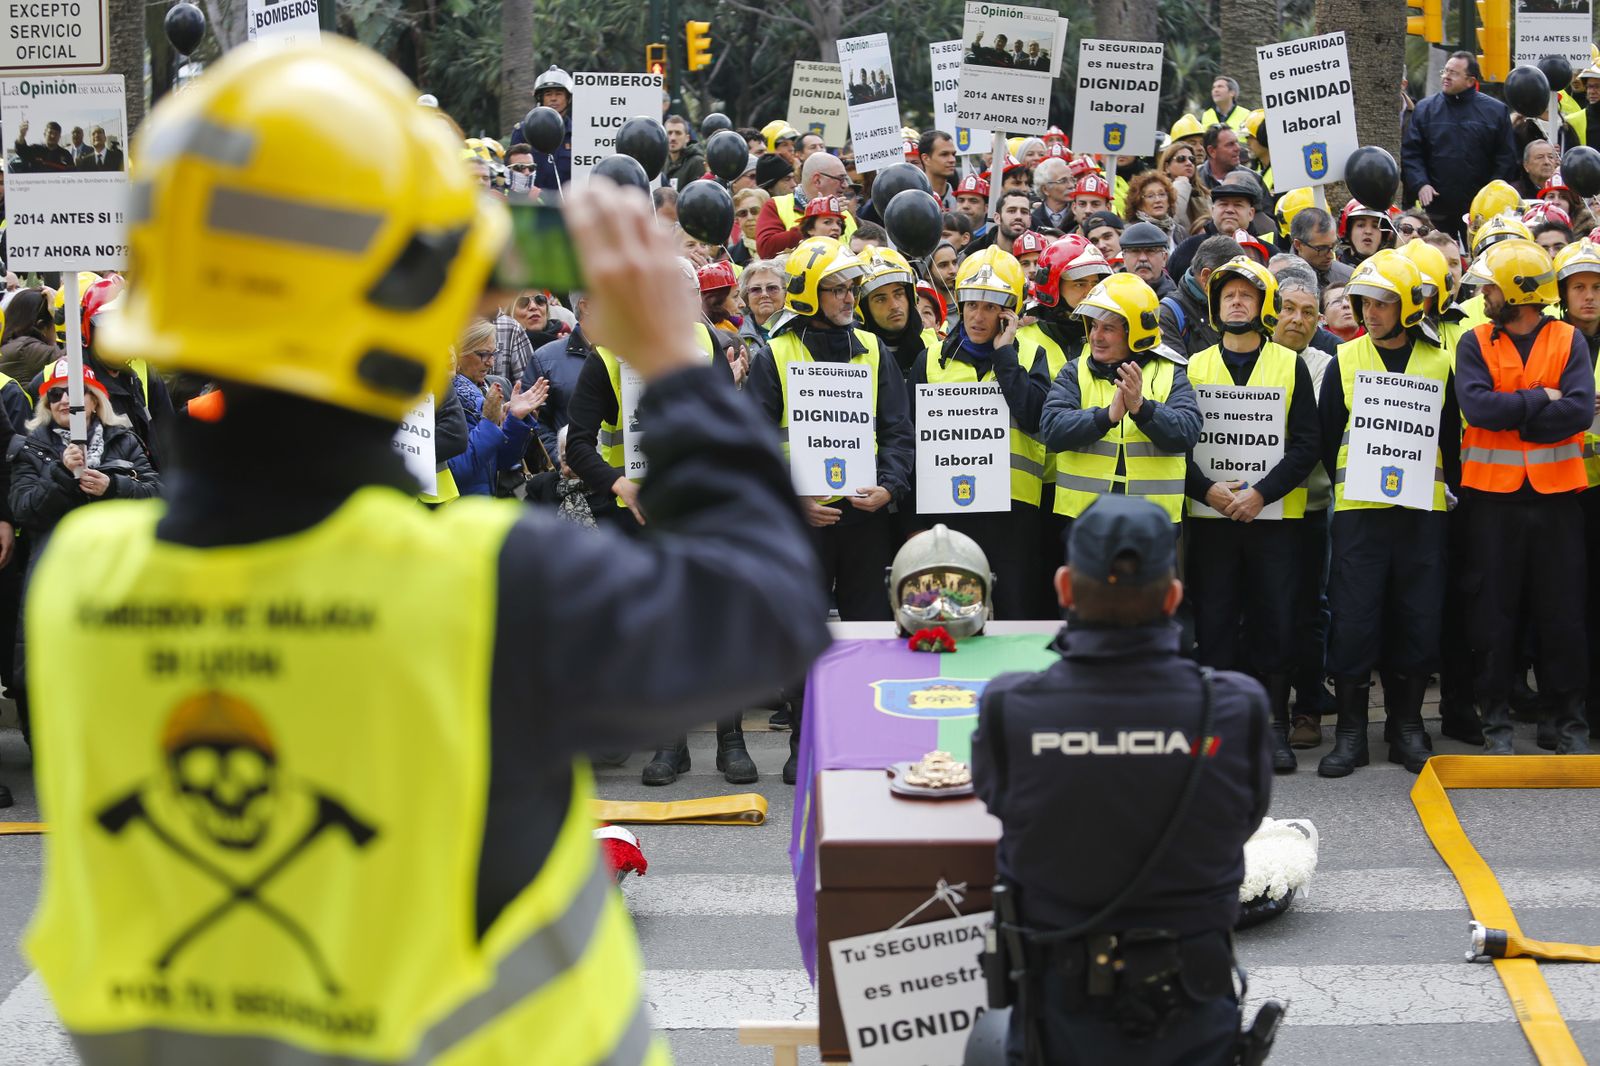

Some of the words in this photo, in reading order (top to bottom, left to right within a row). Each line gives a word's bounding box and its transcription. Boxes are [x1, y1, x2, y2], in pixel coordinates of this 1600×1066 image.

[10, 3, 80, 18] EXCEPTO
[255, 0, 318, 28] BOMBEROS
[10, 23, 82, 39] SERVICIO
[16, 44, 77, 60] OFICIAL
[931, 46, 940, 55] Tu
[1082, 43, 1095, 51] Tu
[1098, 43, 1162, 54] SEGURIDAD
[1258, 50, 1273, 60] Tu
[1276, 36, 1345, 57] SEGURIDAD
[1517, 53, 1537, 61] 2017
[1569, 53, 1591, 61] NO??
[937, 62, 947, 71] es
[1087, 61, 1102, 69] es
[1106, 61, 1154, 71] nuestra
[1269, 70, 1285, 80] es
[1289, 59, 1341, 77] nuestra
[574, 75, 662, 87] BOMBEROS
[1079, 77, 1159, 92] DIGNIDAD
[610, 97, 626, 105] EN
[964, 90, 988, 99] 2014
[991, 92, 1024, 103] ANTES
[1026, 96, 1036, 105] SI
[1265, 80, 1351, 109] DIGNIDAD
[799, 105, 840, 116] laboral
[1090, 100, 1145, 114] laboral
[591, 117, 627, 127] LUC
[958, 111, 981, 121] 2017
[983, 114, 1018, 124] AHORA
[1021, 117, 1047, 127] NO??
[1282, 110, 1342, 134] laboral
[854, 131, 868, 141] 2014
[870, 126, 887, 137] ANTES
[856, 153, 869, 164] 2017
[870, 149, 889, 161] AHORA
[13, 213, 45, 225] 2014
[50, 212, 95, 225] ANTES
[98, 212, 111, 224] SI
[9, 246, 40, 258] 2017
[44, 245, 91, 258] AHORA
[95, 245, 130, 257] NO??
[790, 367, 805, 376] Tu
[808, 367, 869, 379] SEGURIDAD
[1358, 374, 1372, 384] Tu
[1375, 375, 1439, 394] SEGURIDAD
[799, 388, 815, 397] es
[818, 388, 864, 399] nuestra
[919, 388, 934, 397] Tu
[1198, 389, 1212, 398] Tu
[1215, 391, 1281, 401] SEGURIDAD
[927, 409, 944, 417] es
[947, 406, 999, 417] nuestra
[1364, 396, 1380, 405] es
[1383, 398, 1432, 413] nuestra
[792, 409, 871, 424] DIGNIDAD
[1205, 411, 1221, 420] es
[1223, 411, 1273, 422] nuestra
[920, 427, 1006, 442] DIGNIDAD
[1354, 416, 1436, 438] DIGNIDAD
[807, 435, 861, 450] laboral
[1198, 431, 1280, 447] DIGNIDAD
[1366, 442, 1423, 462] laboral
[934, 453, 994, 467] laboral
[1210, 457, 1267, 472] laboral
[1031, 730, 1193, 757] POLICIA
[841, 949, 866, 964] Tu
[873, 921, 991, 959] SEGURIDA
[864, 984, 892, 1000] es
